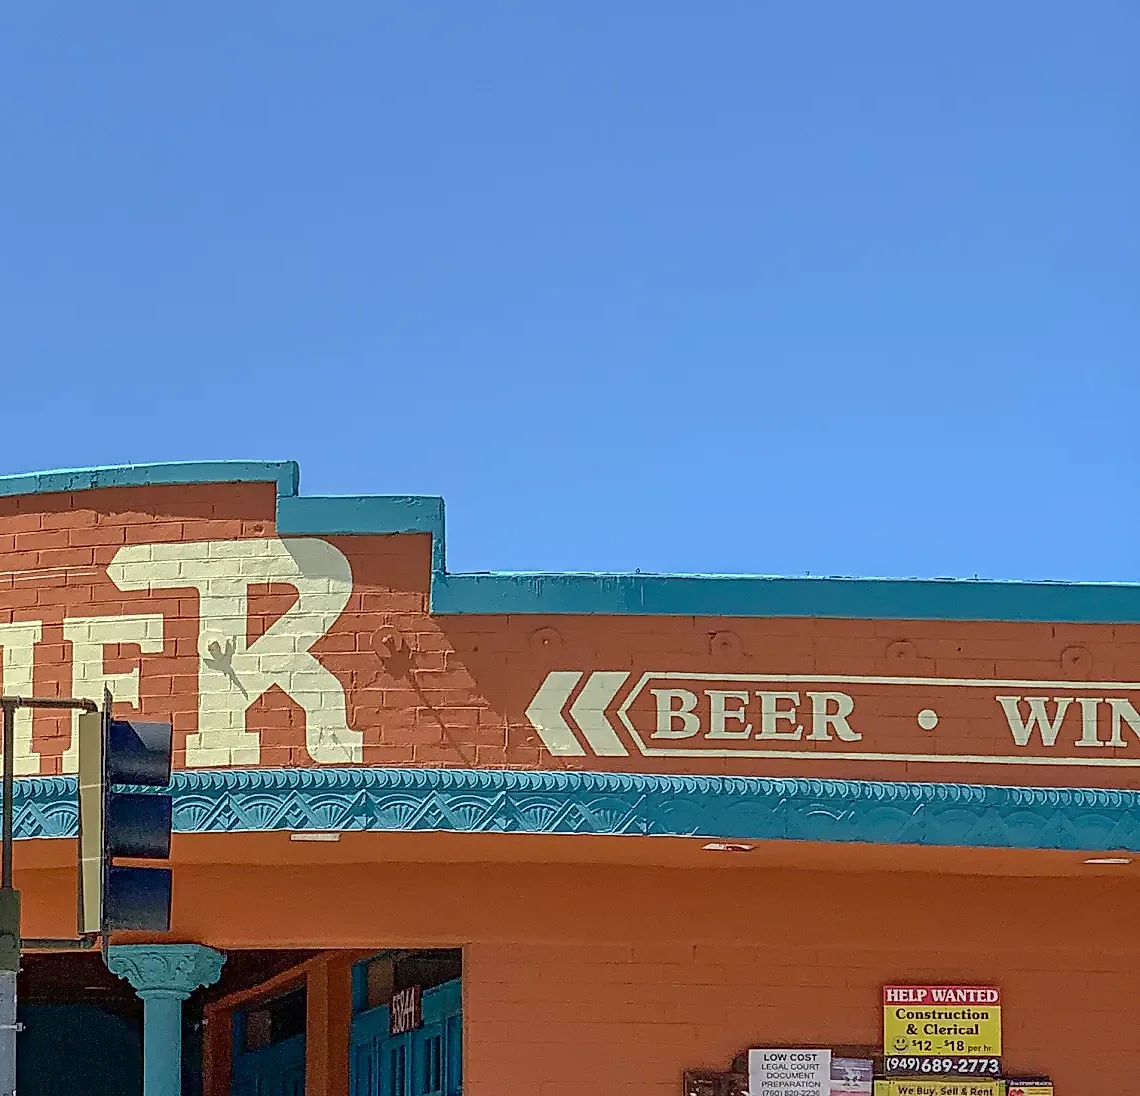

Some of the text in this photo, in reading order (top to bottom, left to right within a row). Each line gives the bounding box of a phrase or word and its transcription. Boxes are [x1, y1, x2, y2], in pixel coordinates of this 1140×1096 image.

[650, 687, 862, 742] BEER
[886, 988, 999, 1003] HELP WANTED
[895, 1008, 989, 1020] Construction
[906, 1023, 979, 1035] & Clerical
[911, 1039, 932, 1052] $12
[967, 1045, 982, 1053] per
[763, 1053, 818, 1062] LOW COST
[761, 1063, 820, 1071] LEGAL COURT
[897, 1086, 914, 1096] We
[939, 1087, 959, 1096] Sell
[960, 1087, 968, 1096] &
[970, 1088, 993, 1096] Rent
